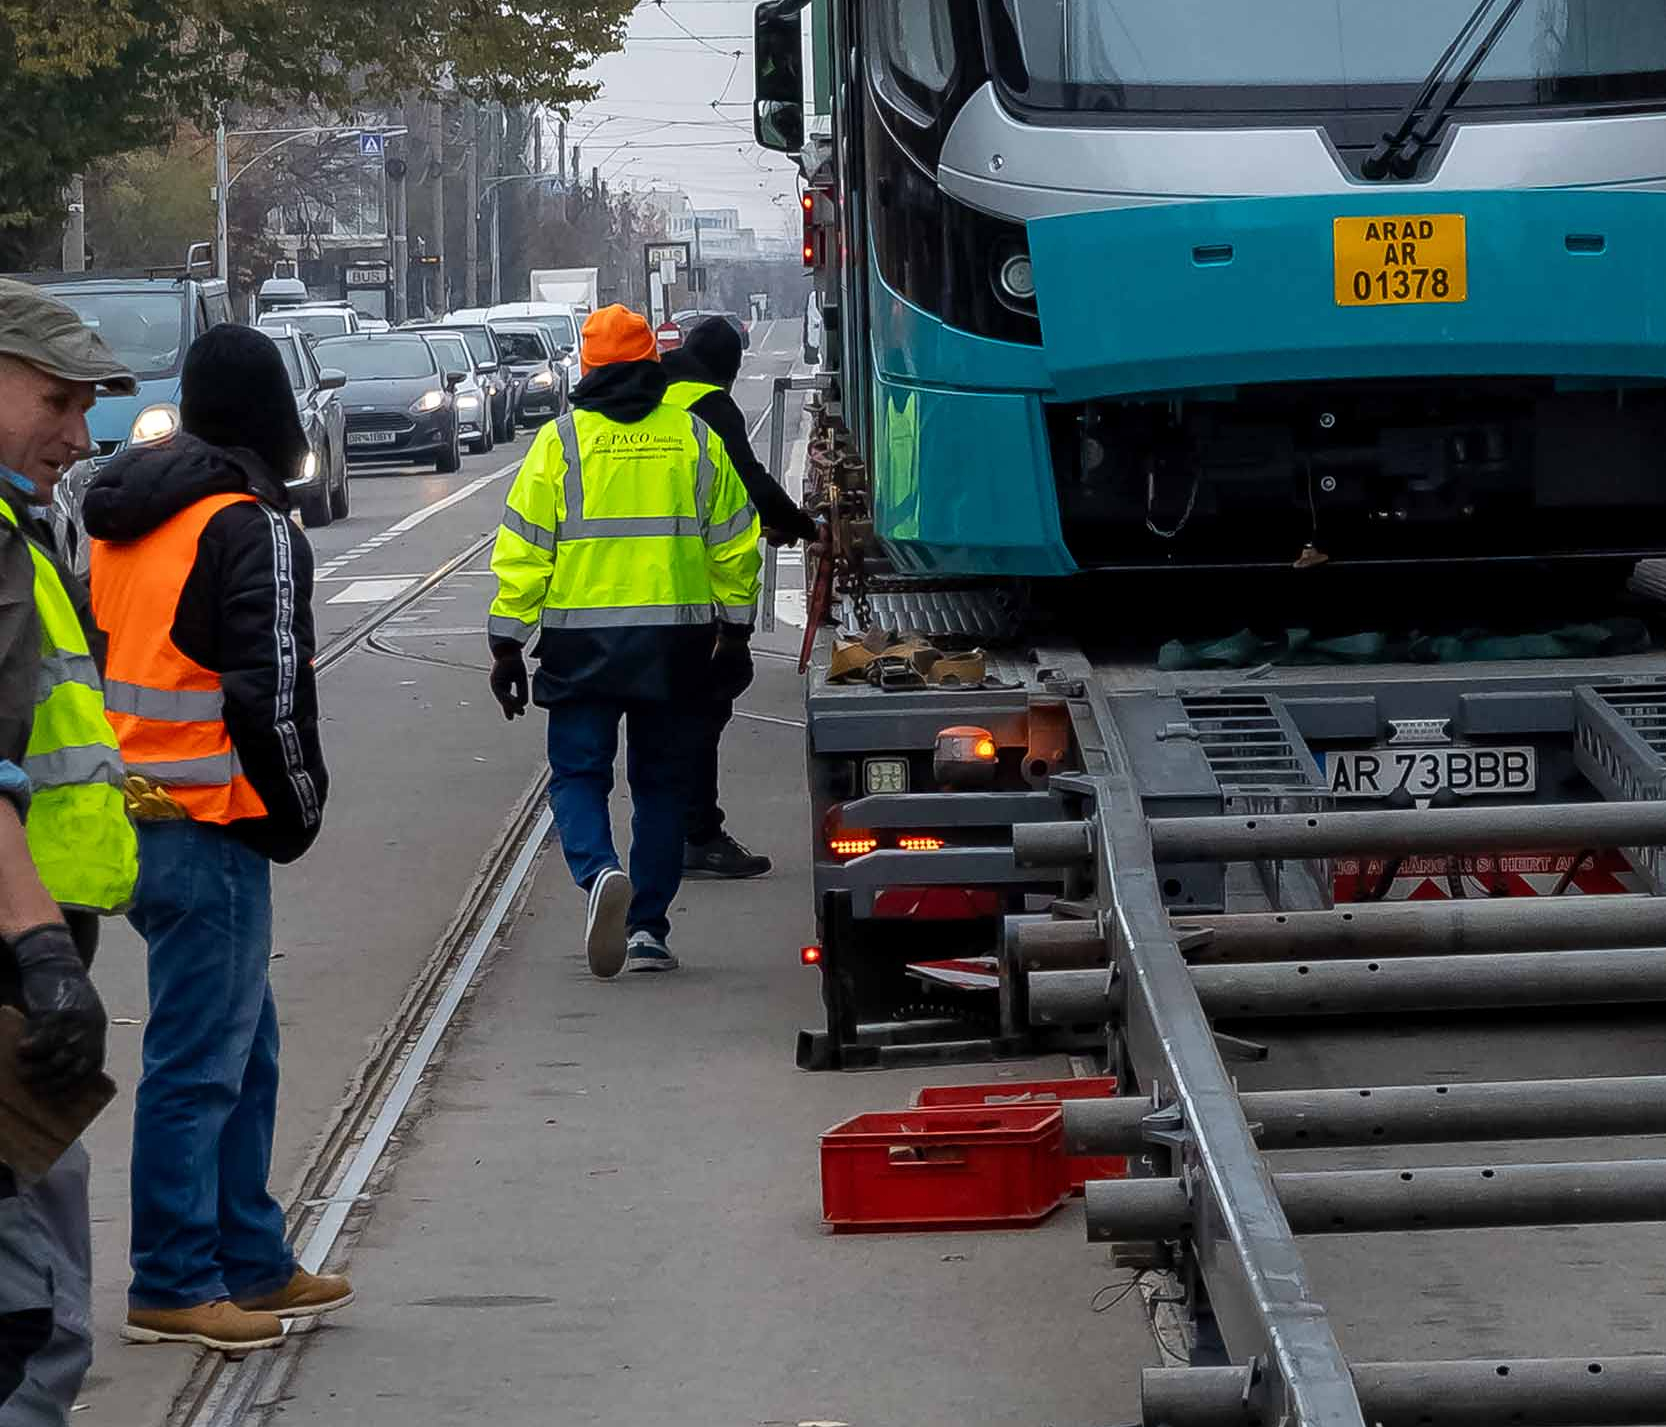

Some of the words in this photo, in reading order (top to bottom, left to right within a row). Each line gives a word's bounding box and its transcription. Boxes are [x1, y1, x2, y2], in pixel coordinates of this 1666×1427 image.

[1365, 220, 1434, 241] ARAD
[1384, 242, 1416, 266] AR
[1353, 268, 1449, 300] 01378
[1331, 755, 1381, 793] AR
